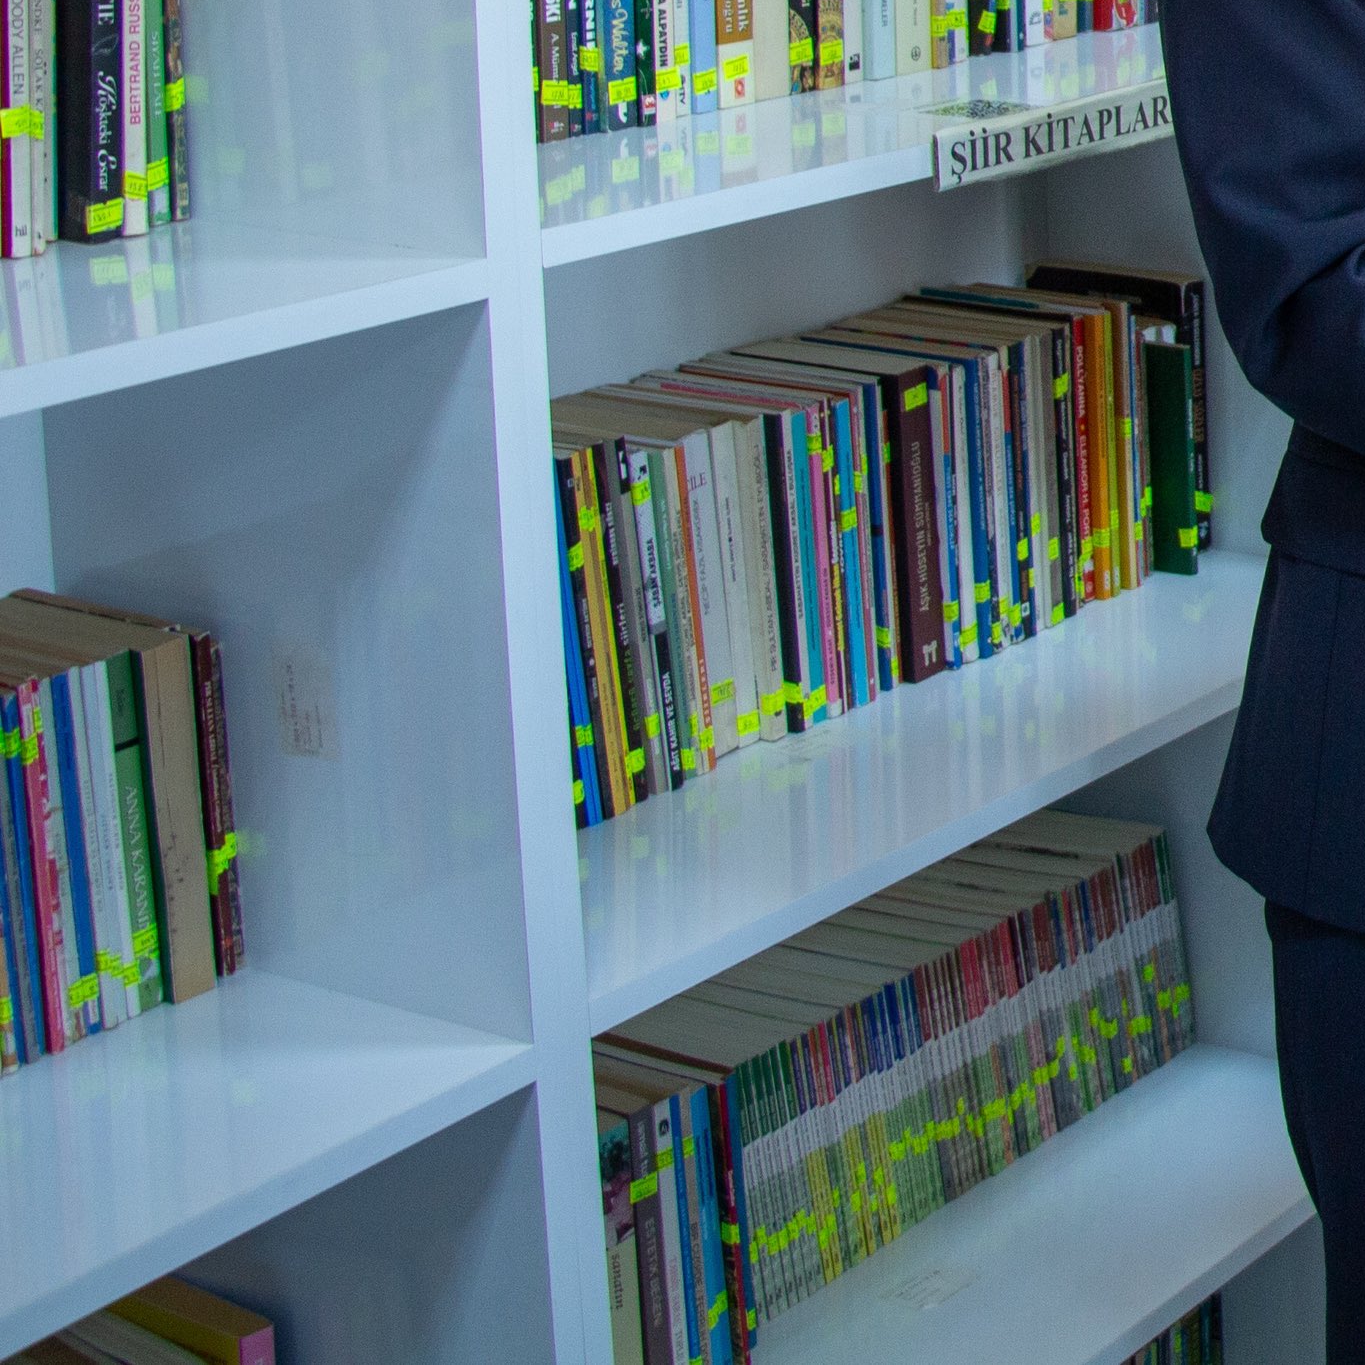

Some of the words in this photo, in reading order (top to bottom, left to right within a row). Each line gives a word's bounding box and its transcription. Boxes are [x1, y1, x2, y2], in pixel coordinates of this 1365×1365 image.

[610, 9, 628, 75] Walter
[657, 9, 668, 67] ALPAYDIN
[12, 45, 24, 95] ALLEN
[128, 41, 142, 125] BERTRAND
[950, 127, 1015, 185] ŞİİR
[1075, 345, 1086, 418] POLLYANNA
[915, 530, 928, 581] HÜSEYİN
[662, 672, 673, 703] SEVDA
[665, 704, 675, 716] VE
[666, 718, 680, 747] KAHIR
[669, 749, 681, 771] AĞIT
